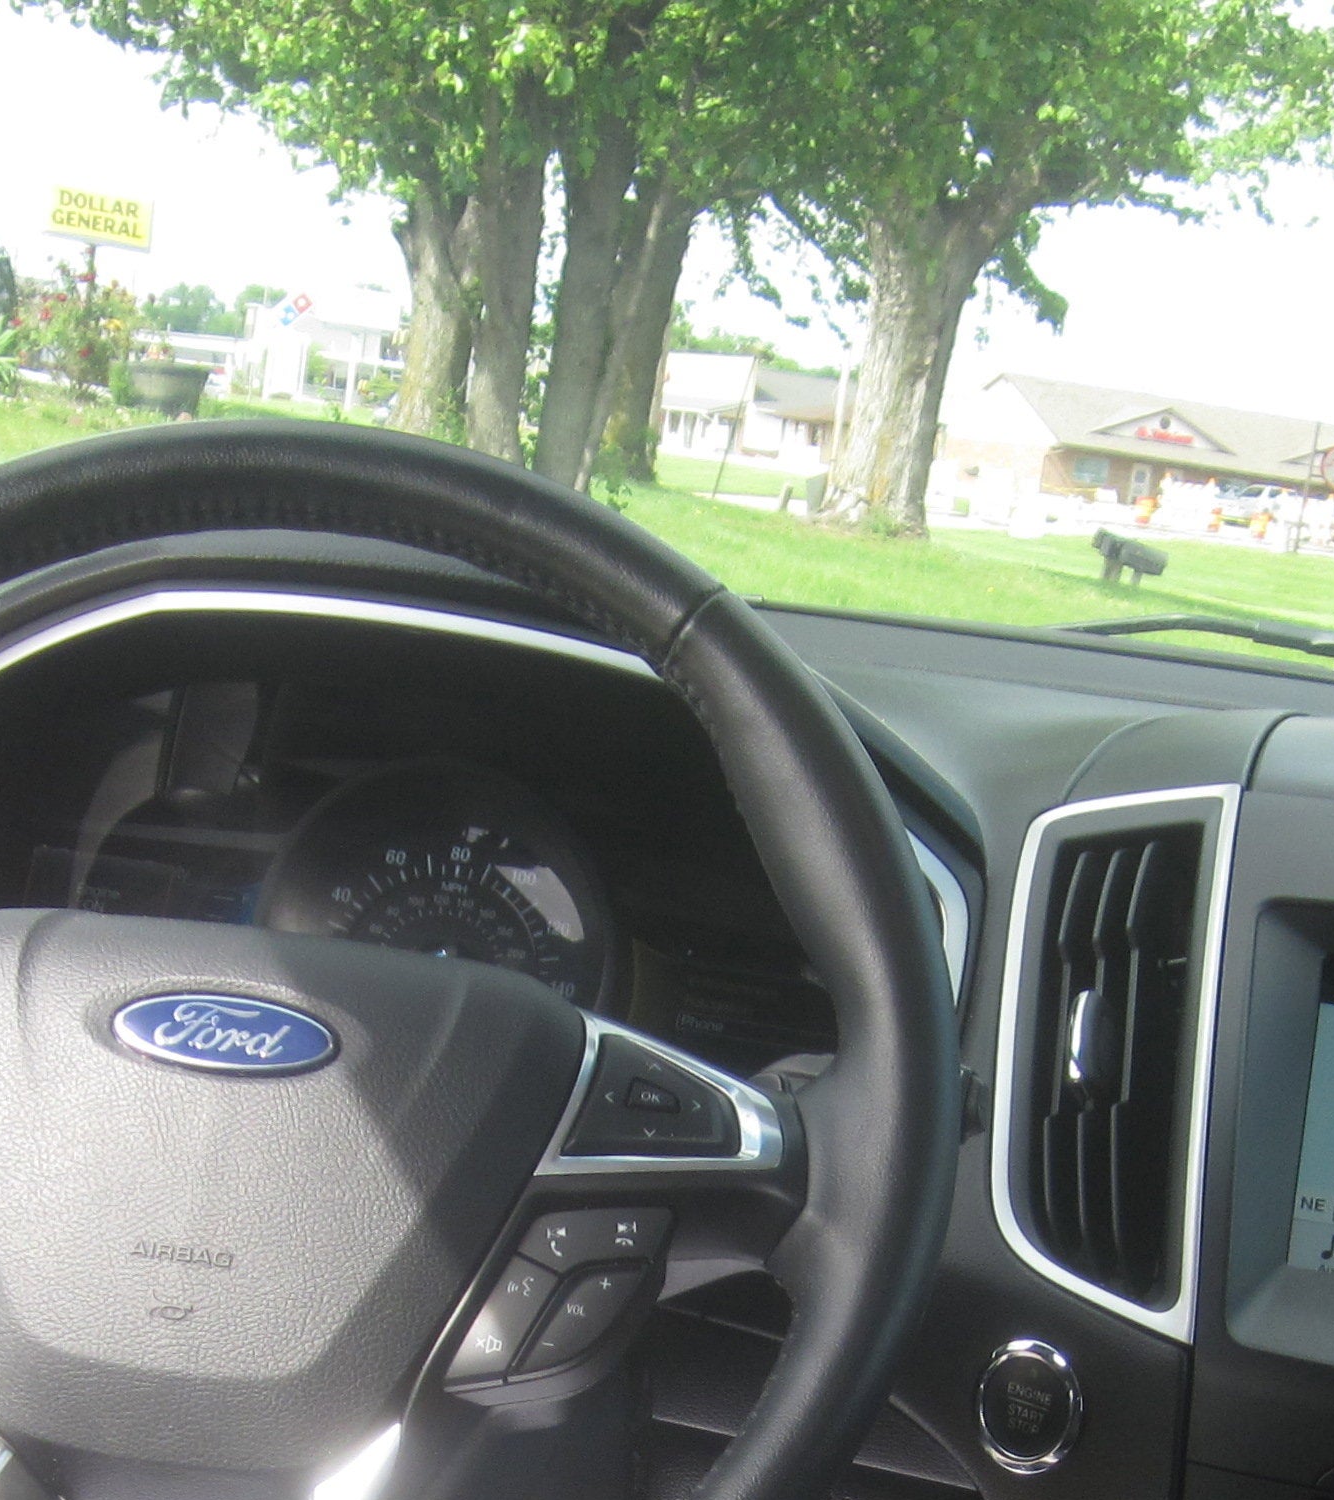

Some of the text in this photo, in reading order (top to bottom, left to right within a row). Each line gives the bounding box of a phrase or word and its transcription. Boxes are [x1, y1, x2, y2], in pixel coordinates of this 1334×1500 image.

[59, 189, 139, 218] DOLLAR
[52, 208, 143, 239] GENERAL
[385, 849, 407, 865] 60
[450, 846, 471, 862] 80
[512, 870, 537, 886] 100
[331, 885, 352, 903] 40
[440, 880, 468, 895] MPH
[550, 982, 575, 999] 140
[152, 1000, 292, 1060] Ford
[640, 1090, 661, 1104] OK
[1300, 1197, 1326, 1213] NE
[129, 1240, 234, 1269] AIRBAG
[566, 1303, 586, 1317] VOL
[1007, 1381, 1053, 1407] ENGINE
[1007, 1403, 1045, 1424] START
[1007, 1417, 1040, 1434] STOP
